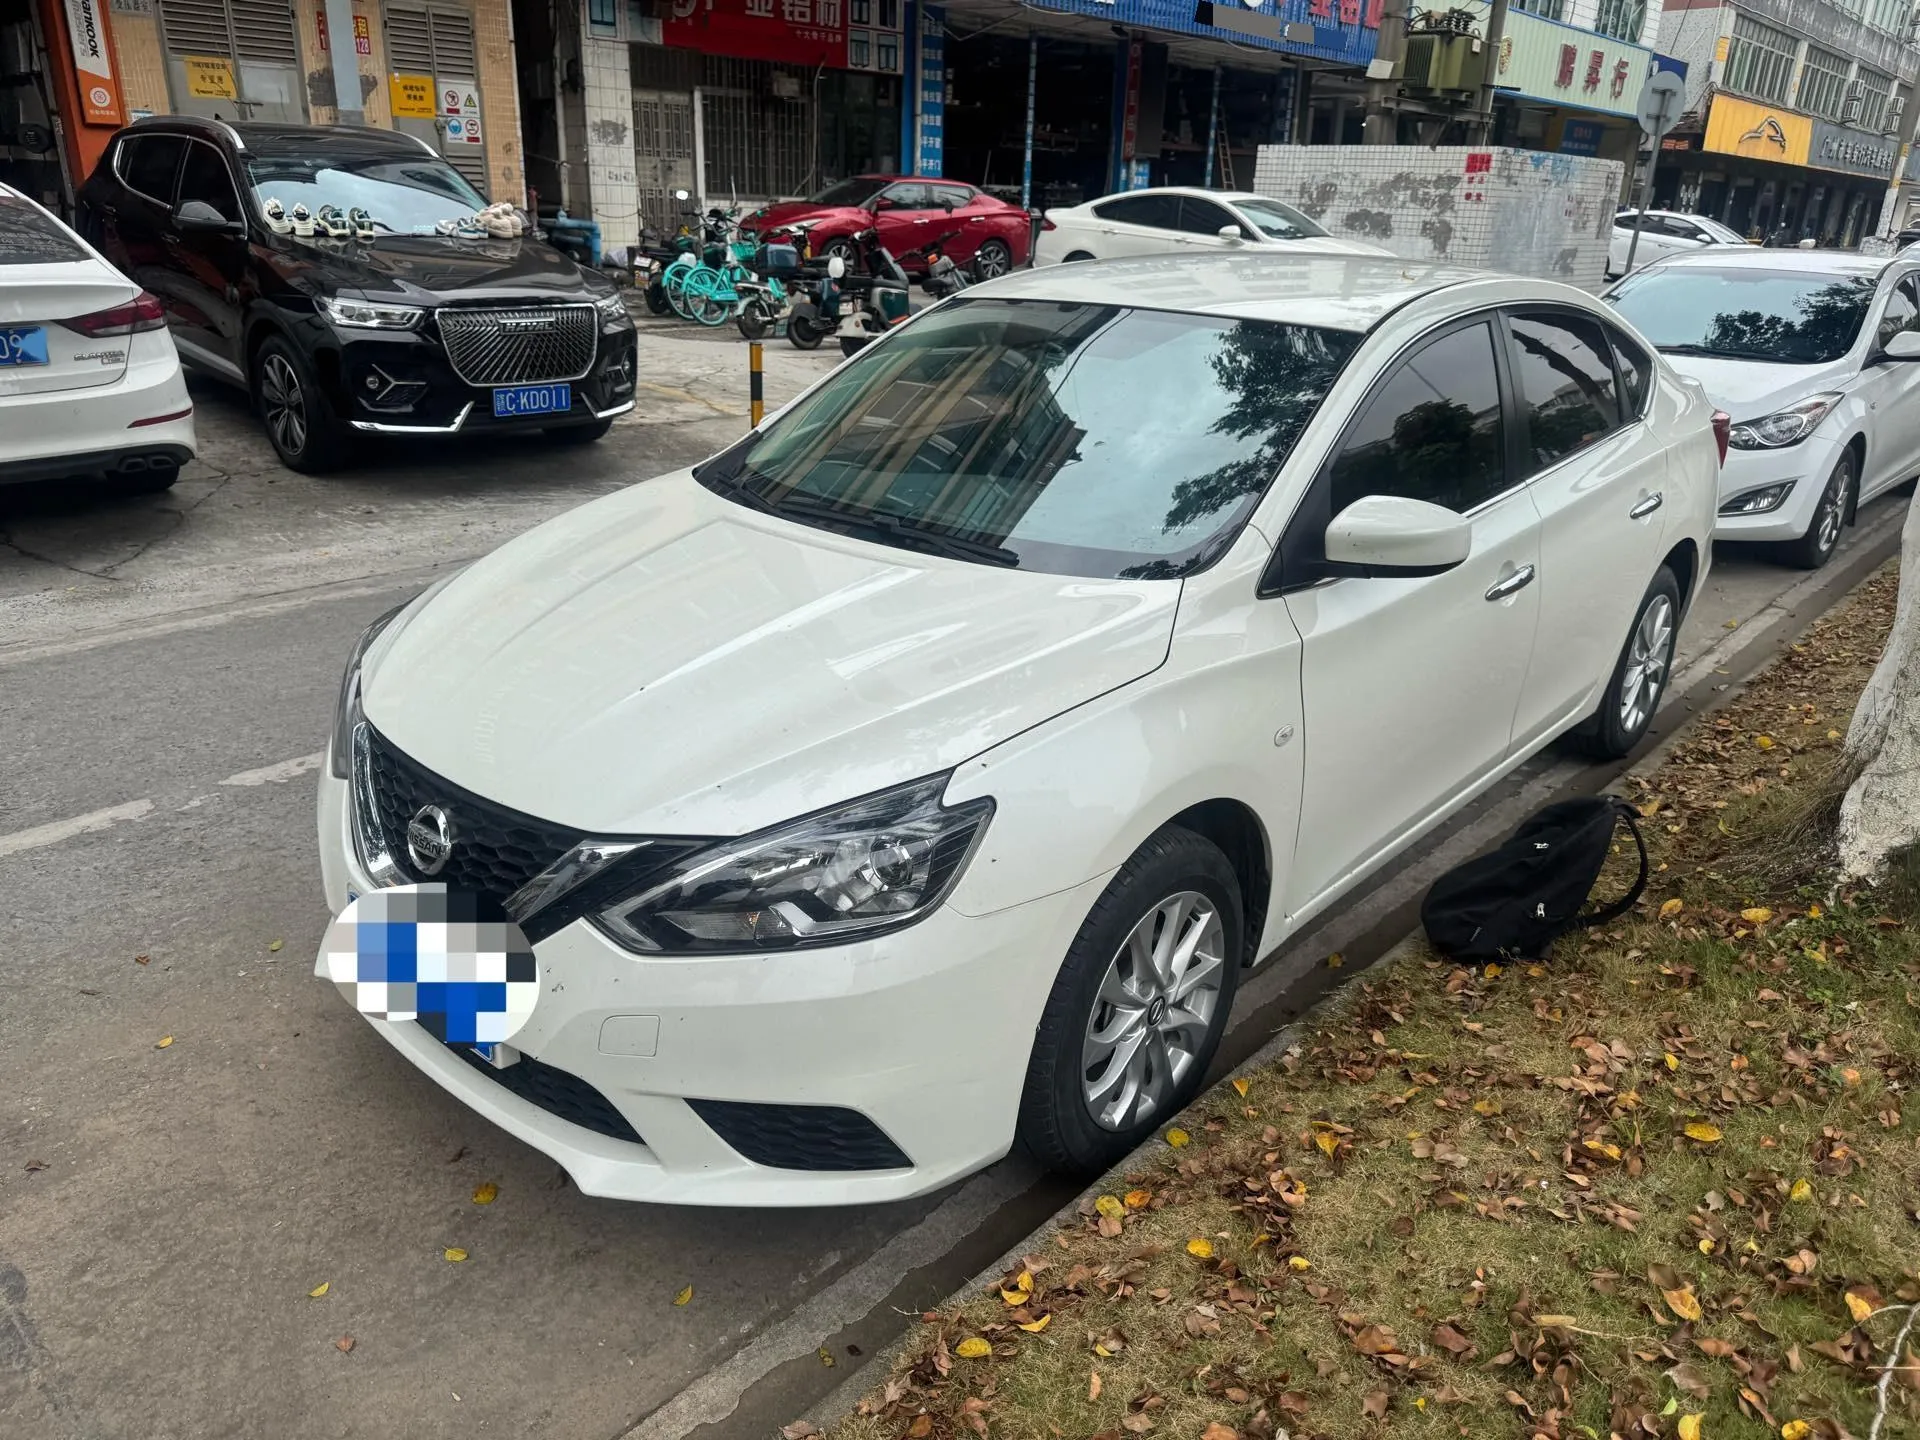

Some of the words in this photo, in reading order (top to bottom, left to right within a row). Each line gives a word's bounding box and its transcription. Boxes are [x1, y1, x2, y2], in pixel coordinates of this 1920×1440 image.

[81, 0, 100, 58] ankook
[504, 321, 554, 332] HAVAL
[409, 830, 443, 857] NISSAN
